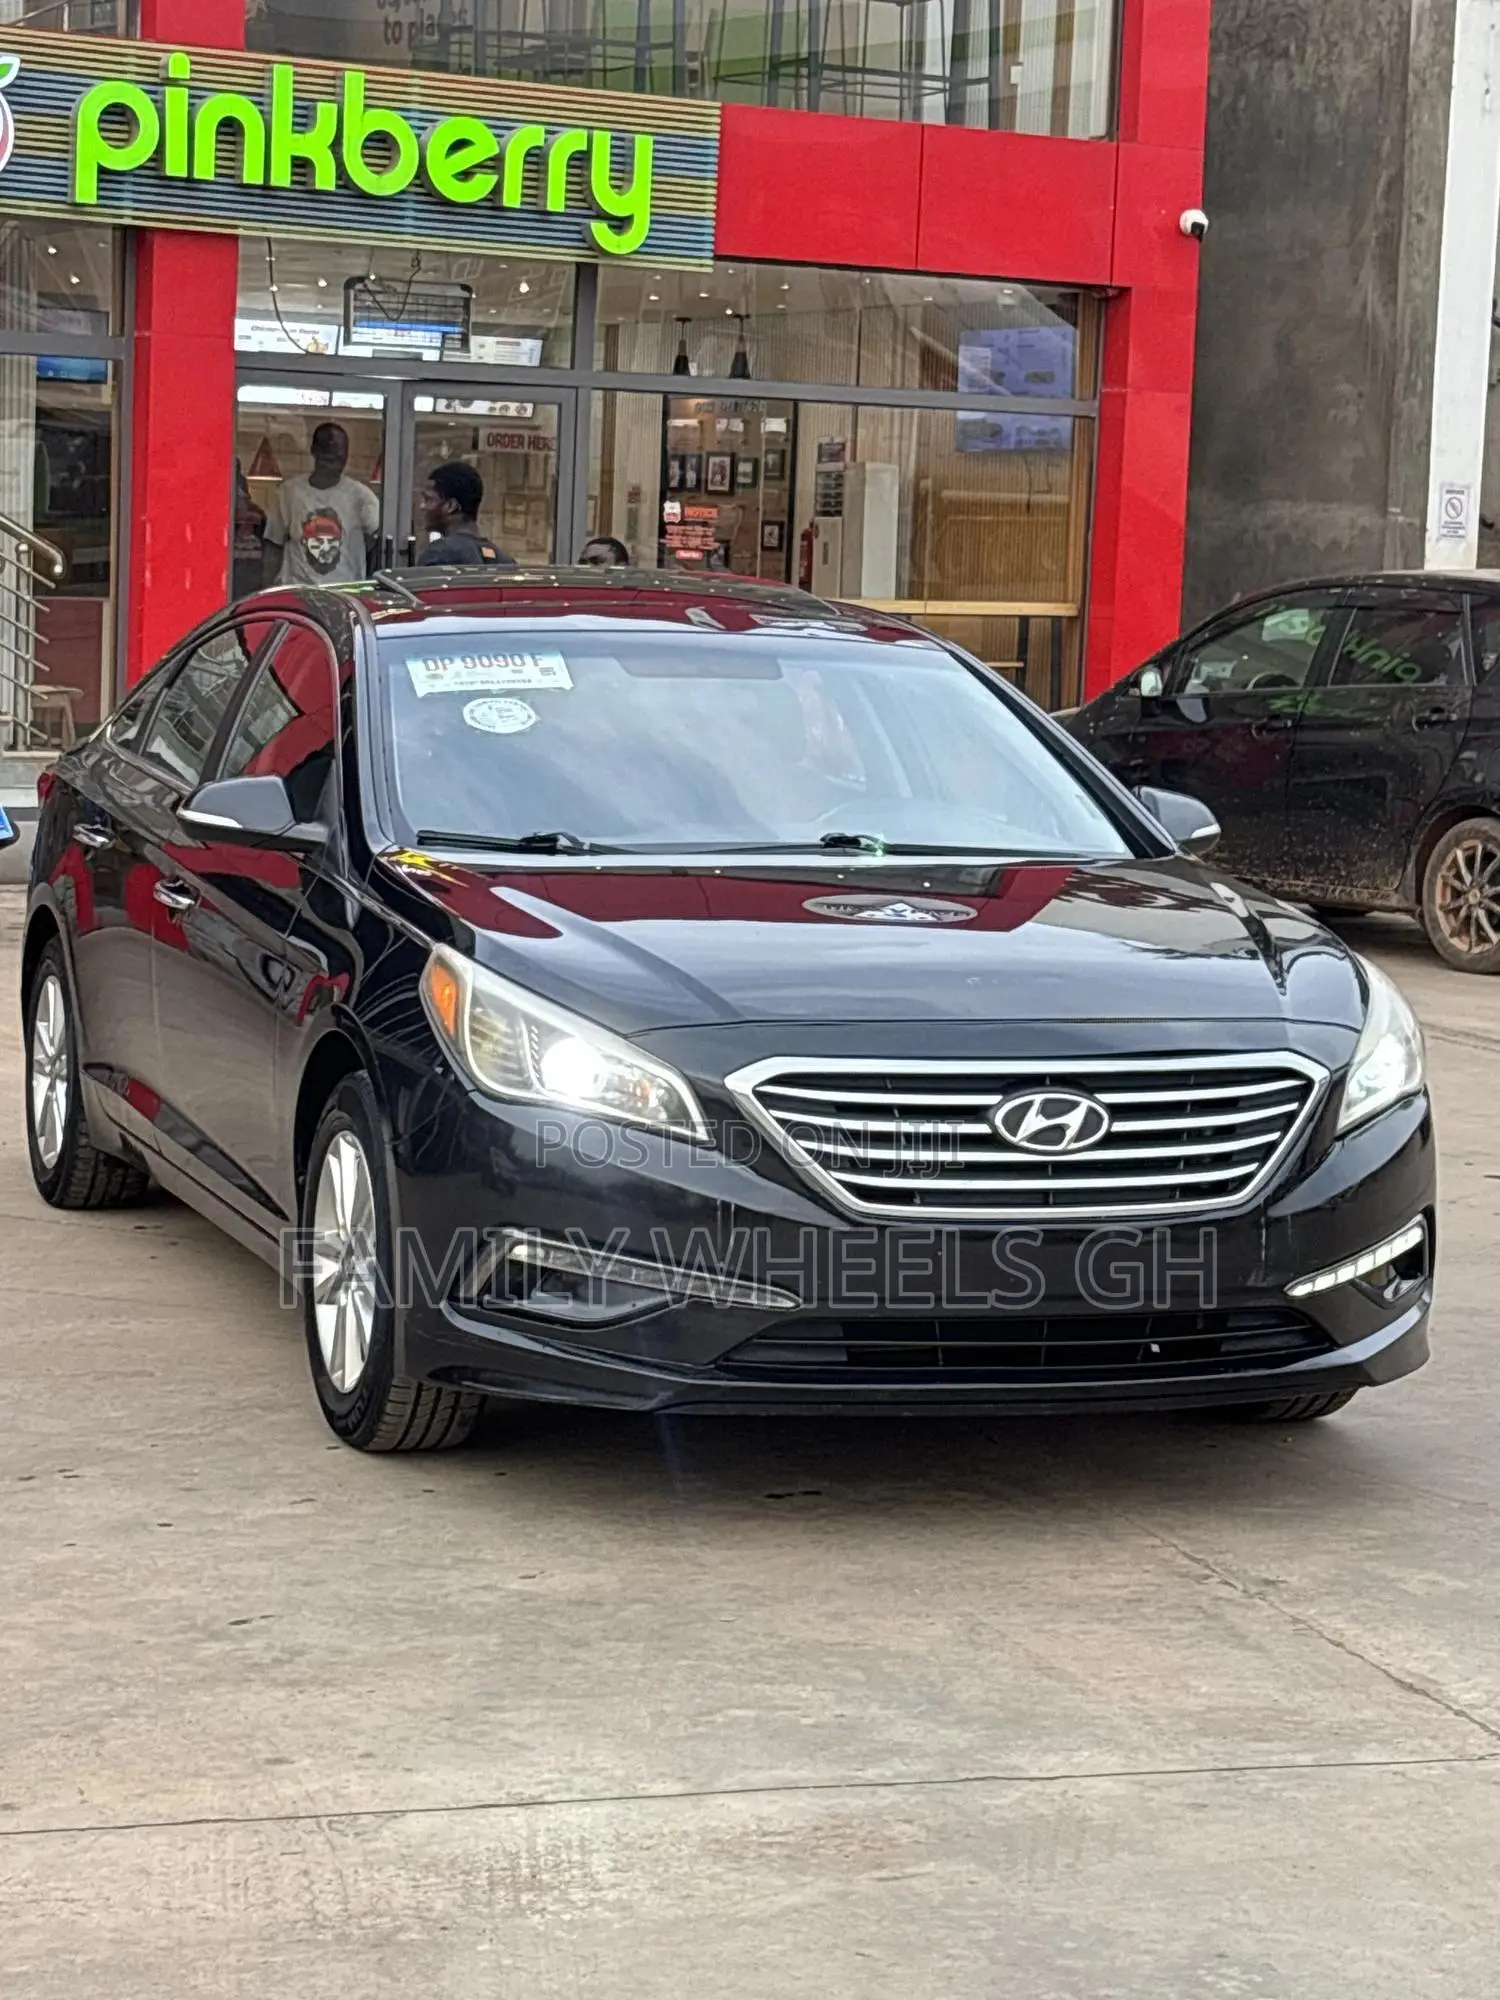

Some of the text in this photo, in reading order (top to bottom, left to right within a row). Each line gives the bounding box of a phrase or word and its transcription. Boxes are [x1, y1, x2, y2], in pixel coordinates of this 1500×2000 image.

[71, 51, 654, 255] pinkberry
[486, 431, 525, 450] ORDER
[460, 652, 527, 670] 9090
